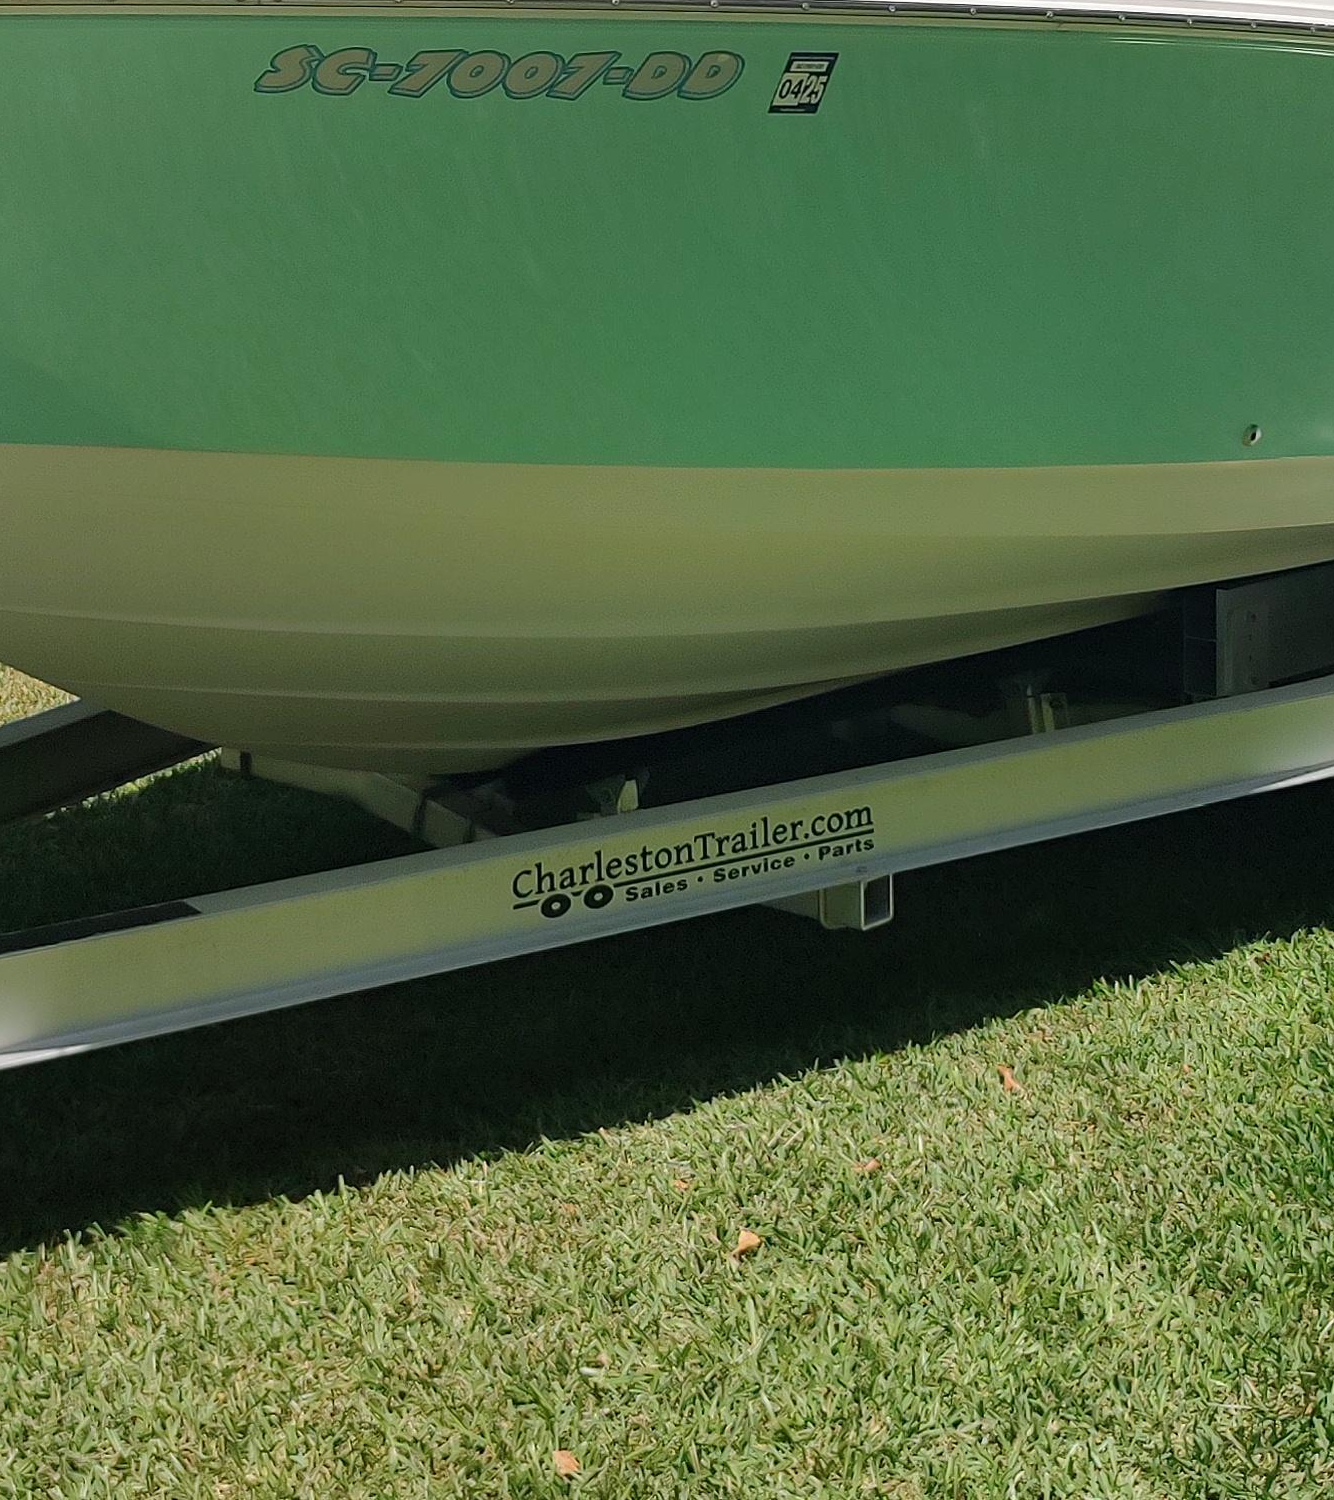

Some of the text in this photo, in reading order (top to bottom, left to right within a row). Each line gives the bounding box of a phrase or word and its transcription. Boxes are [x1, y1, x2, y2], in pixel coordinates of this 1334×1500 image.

[254, 44, 745, 101] SC-7007-DD
[512, 805, 874, 898] CharlestonTrailer.com
[625, 838, 875, 902] Sales Service Parts
